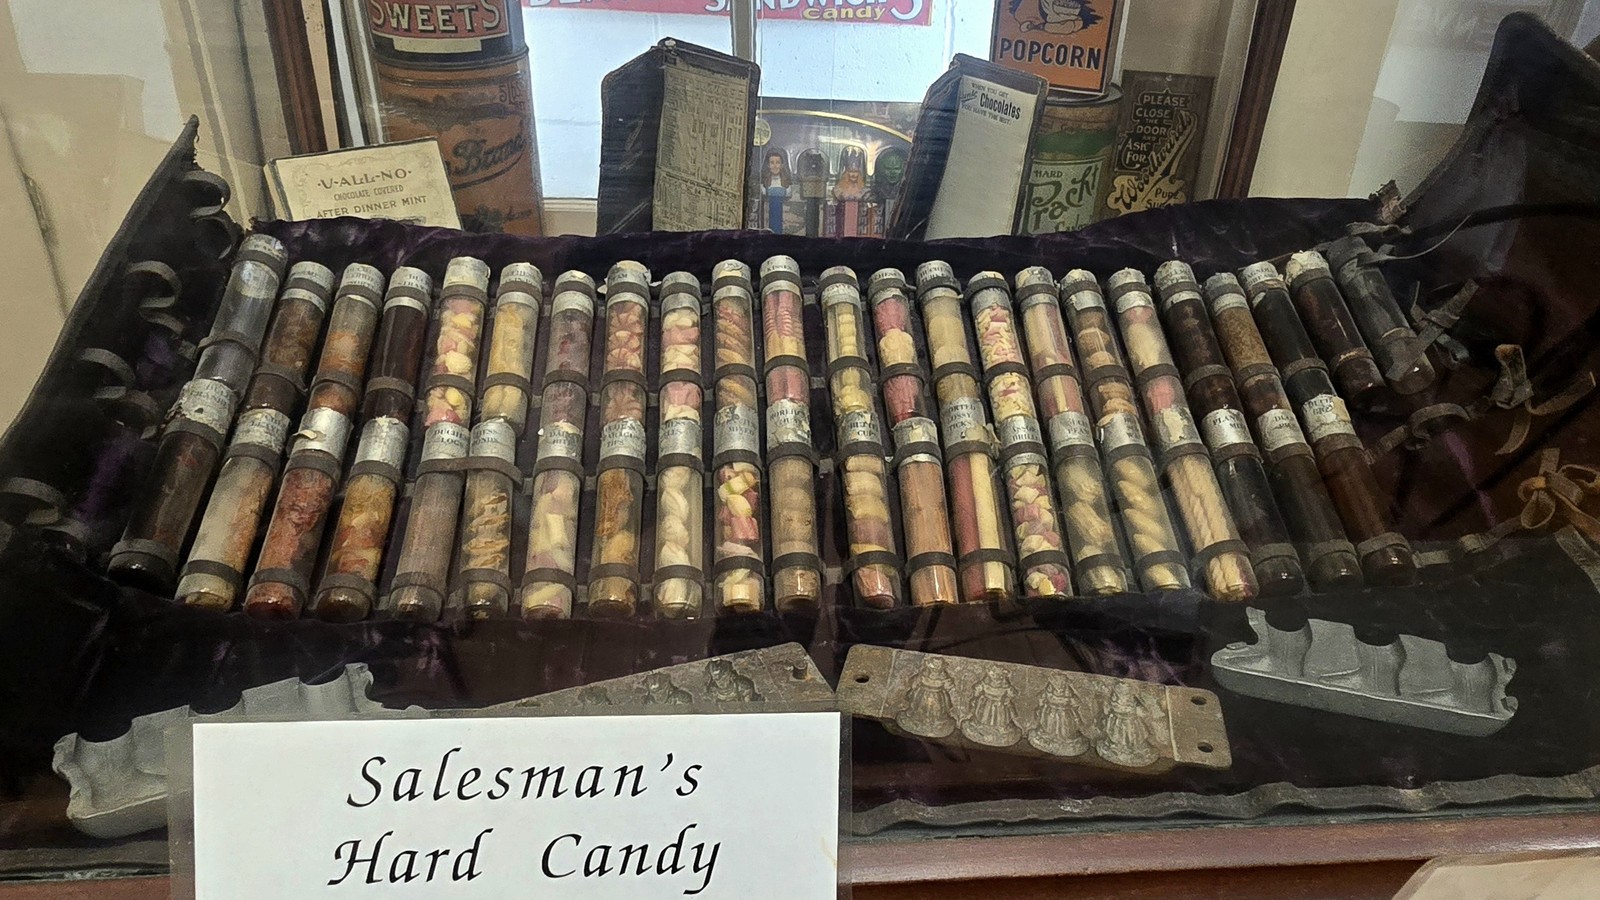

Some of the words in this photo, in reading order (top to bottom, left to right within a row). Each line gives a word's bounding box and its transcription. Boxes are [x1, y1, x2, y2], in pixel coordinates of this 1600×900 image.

[371, 0, 500, 32] SWEETS
[802, 6, 886, 20] candy
[999, 38, 1102, 71] POPCORN
[979, 92, 1021, 120] Chocolates
[1143, 94, 1186, 107] PLEASE
[1135, 107, 1171, 118] CLOSE
[1136, 125, 1167, 136] DOOR
[1126, 138, 1151, 151] ASK
[1125, 151, 1148, 164] FOR
[1033, 170, 1063, 178] HARD
[333, 189, 370, 201] CHOCOLATE
[373, 184, 404, 196] COVERED
[316, 206, 349, 219] AFTER
[354, 200, 397, 213] DINNER
[401, 195, 427, 206] MINT
[346, 746, 704, 808] Salesman's
[326, 827, 496, 887] Hard
[540, 823, 722, 895] Candy
